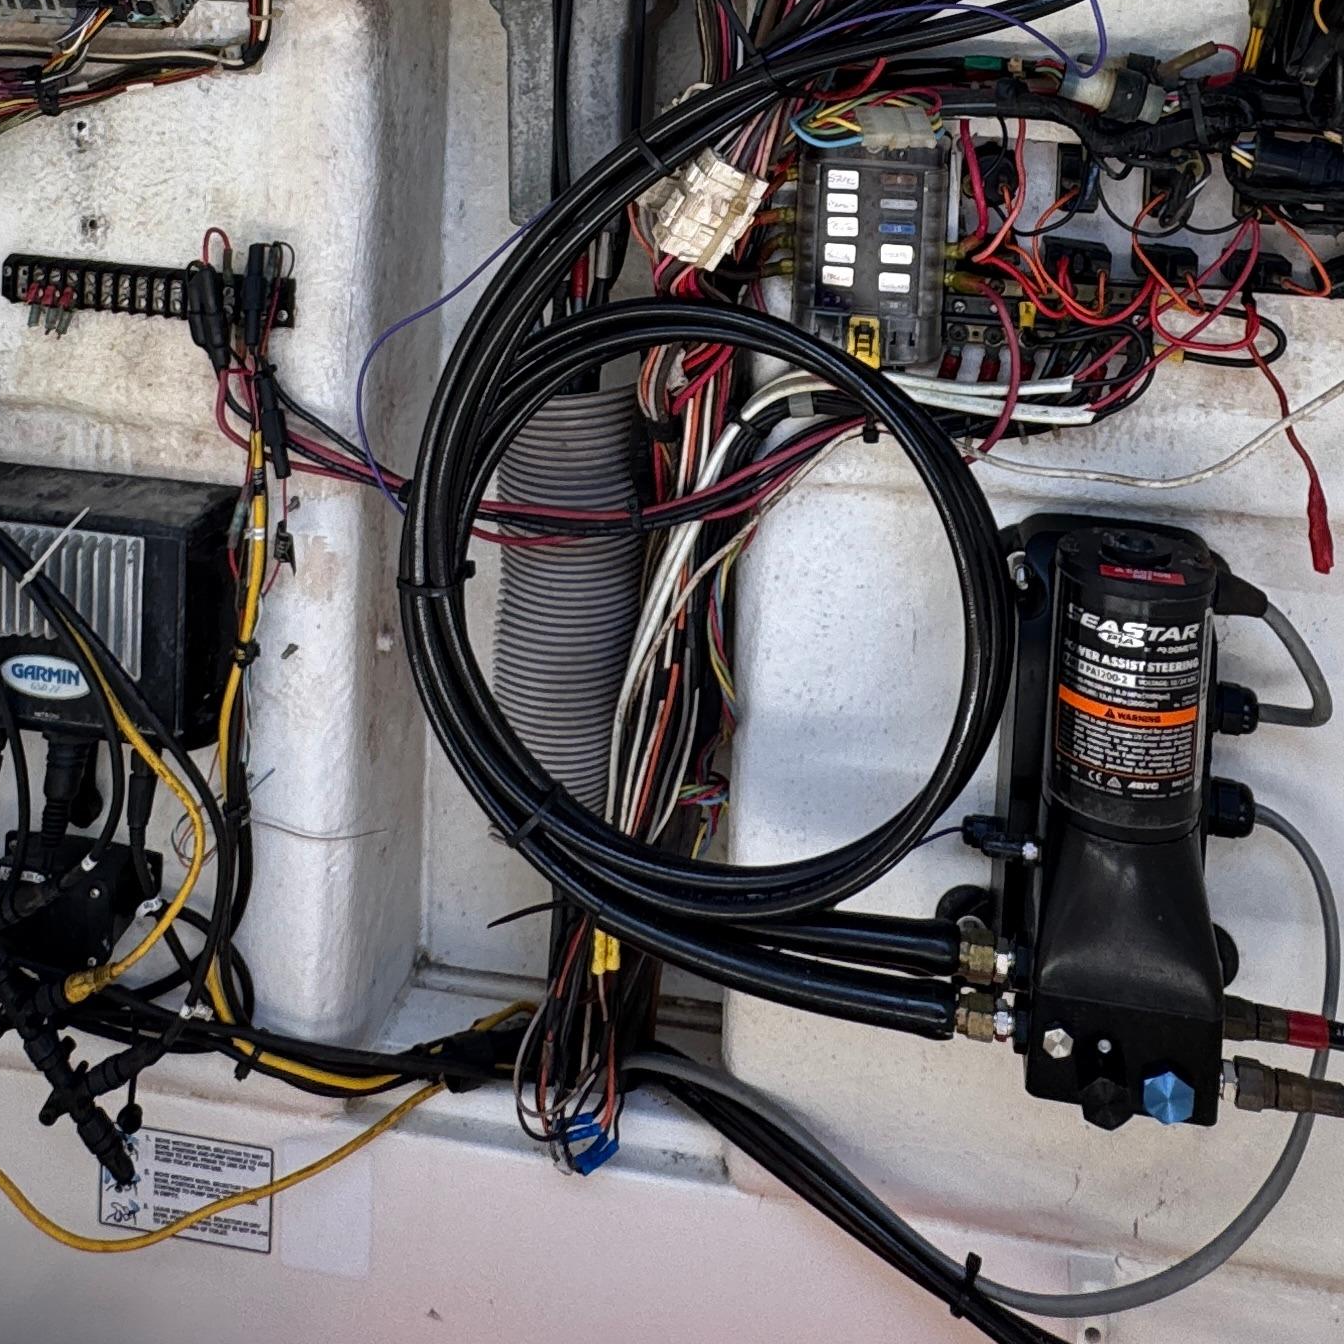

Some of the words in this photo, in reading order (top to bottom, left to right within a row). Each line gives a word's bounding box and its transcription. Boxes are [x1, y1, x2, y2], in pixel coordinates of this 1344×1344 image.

[1101, 654, 1145, 672] ASSIST
[1147, 657, 1200, 673] STEERING
[11, 663, 80, 686] GARMIN
